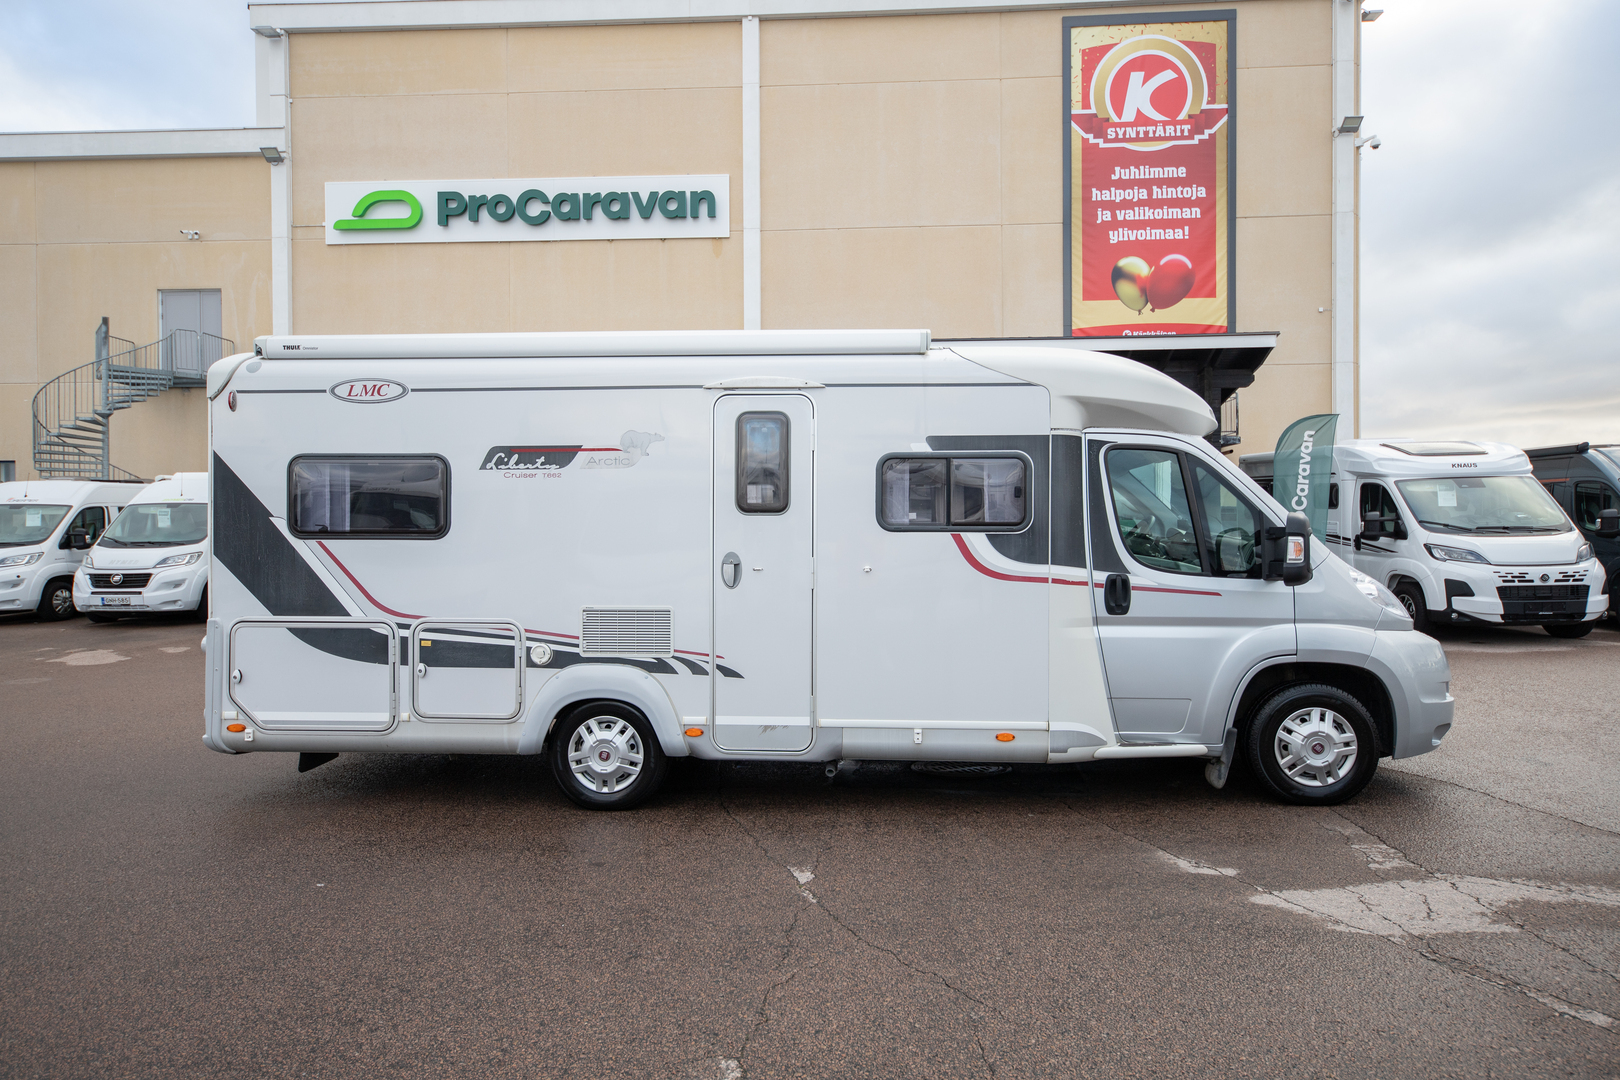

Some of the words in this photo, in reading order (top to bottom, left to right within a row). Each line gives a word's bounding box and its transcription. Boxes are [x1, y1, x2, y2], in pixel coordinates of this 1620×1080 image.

[1120, 69, 1179, 122] K
[1107, 123, 1191, 139] SYNTTÄRIT
[1111, 165, 1187, 180] Juhlimme
[1091, 186, 1148, 202] halpoja
[1152, 184, 1206, 200] hintoja
[437, 188, 717, 227] ProCaravan
[1096, 208, 1112, 224] ja
[1115, 206, 1201, 221] valikoiman
[1108, 226, 1189, 244] ylivoimaa!
[346, 383, 390, 397] LMC
[485, 452, 560, 471] Liberty
[585, 456, 631, 466] Arctic
[503, 471, 538, 479] Cruiser
